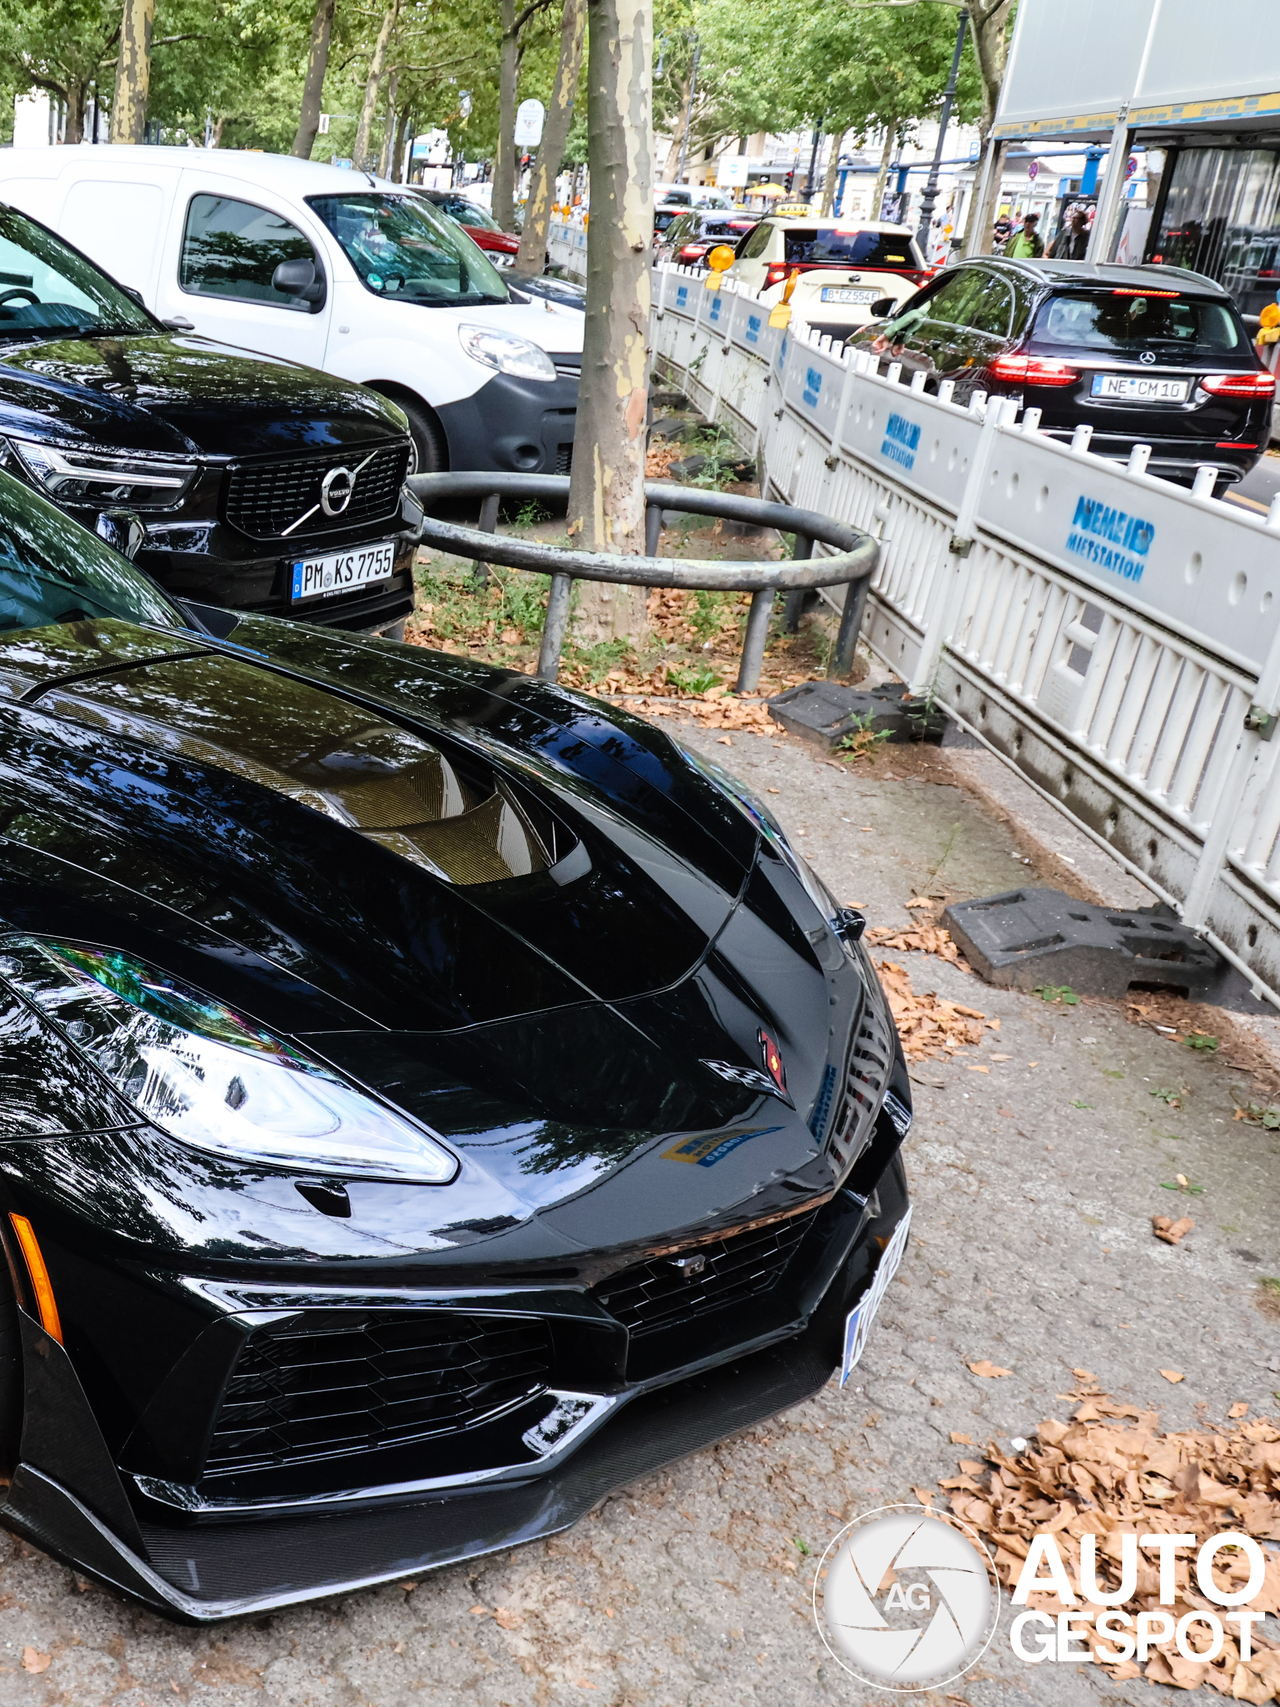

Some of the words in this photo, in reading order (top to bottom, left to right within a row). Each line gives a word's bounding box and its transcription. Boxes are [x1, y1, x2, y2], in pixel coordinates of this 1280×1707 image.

[827, 289, 834, 300] B
[1108, 379, 1128, 394] NE
[1138, 381, 1158, 396] CM
[1161, 383, 1180, 398] 10
[329, 488, 350, 497] VOLVO
[1072, 494, 1155, 557] NIEMEIER
[304, 561, 324, 592] PM
[334, 556, 354, 585] KS
[357, 547, 392, 580] 7755
[1065, 532, 1144, 583] MIETSTATION
